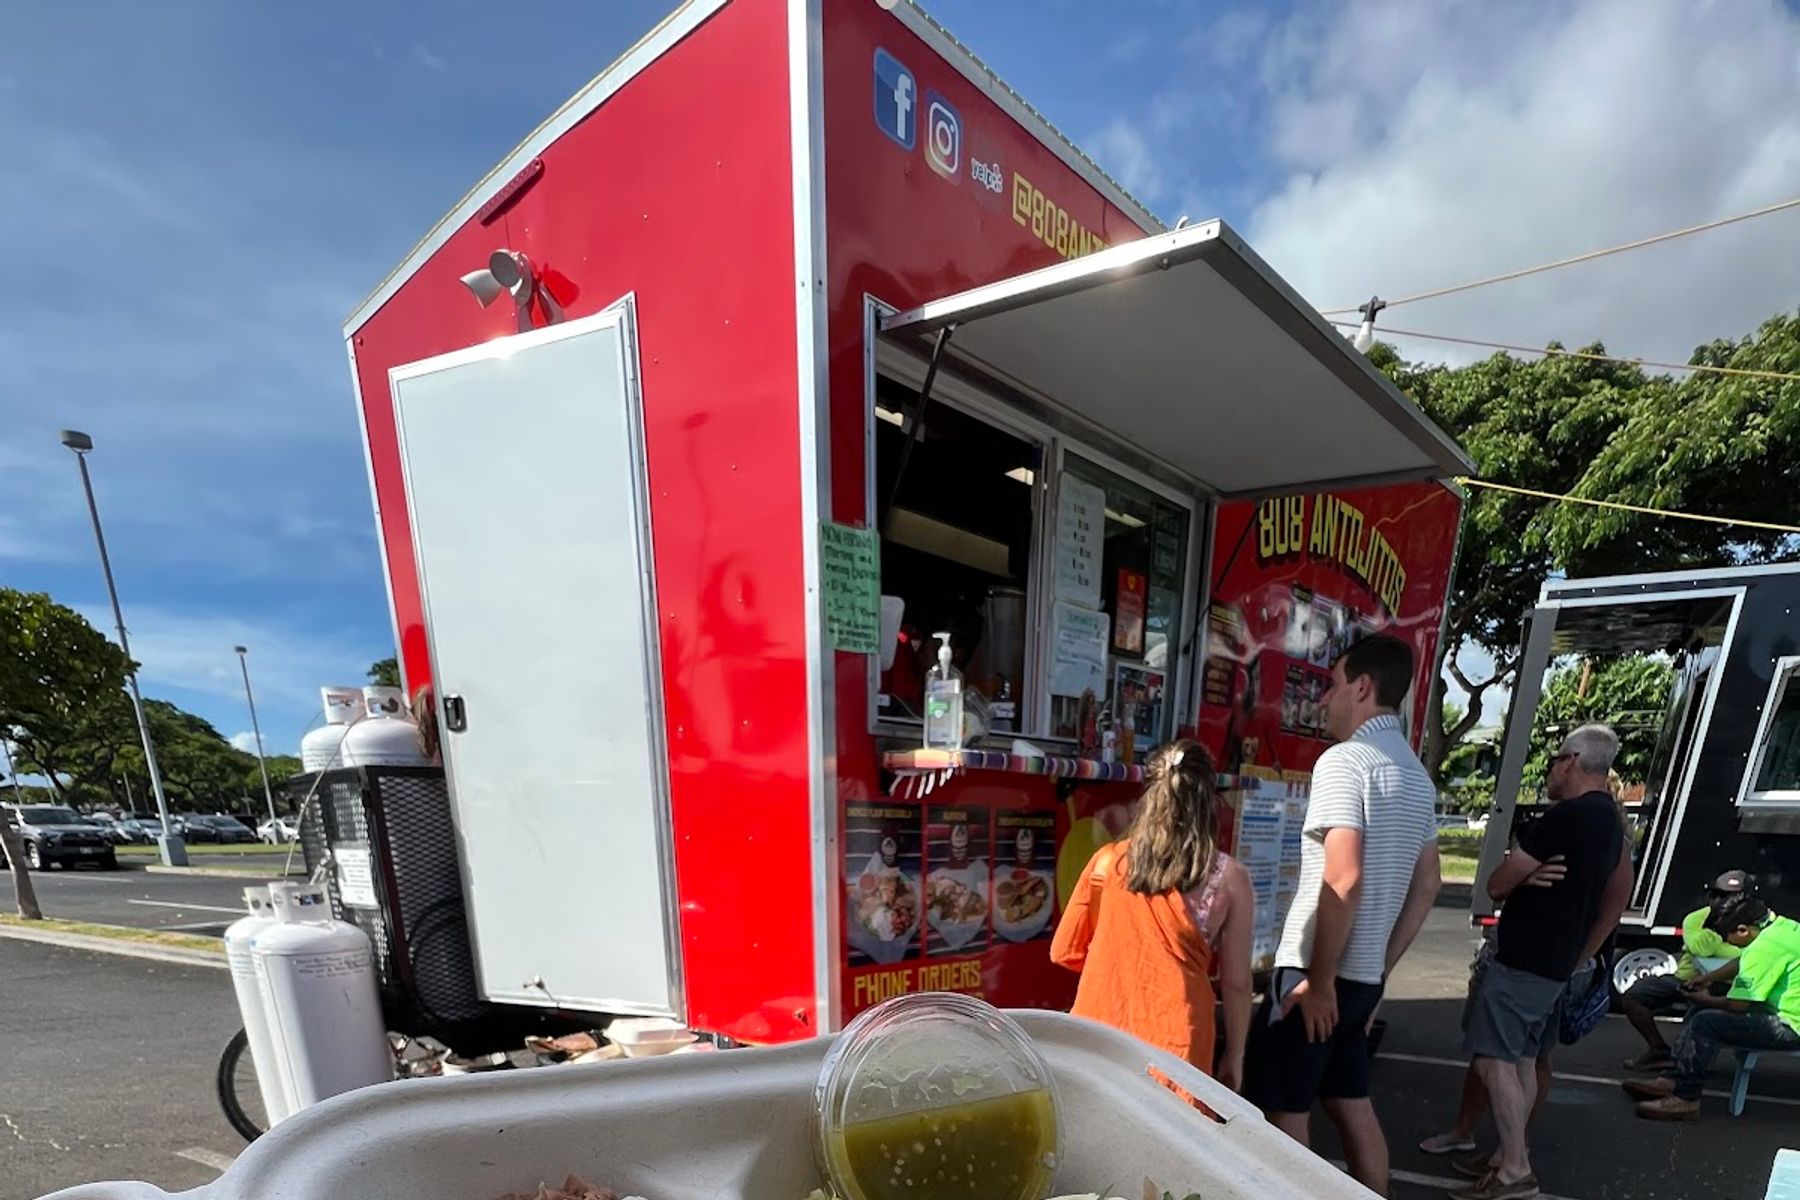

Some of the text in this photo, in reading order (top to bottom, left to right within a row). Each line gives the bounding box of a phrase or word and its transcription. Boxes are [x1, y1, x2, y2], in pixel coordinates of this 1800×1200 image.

[1259, 494, 1407, 619] 808 ANTOJITOS
[918, 960, 982, 992] ORDERS
